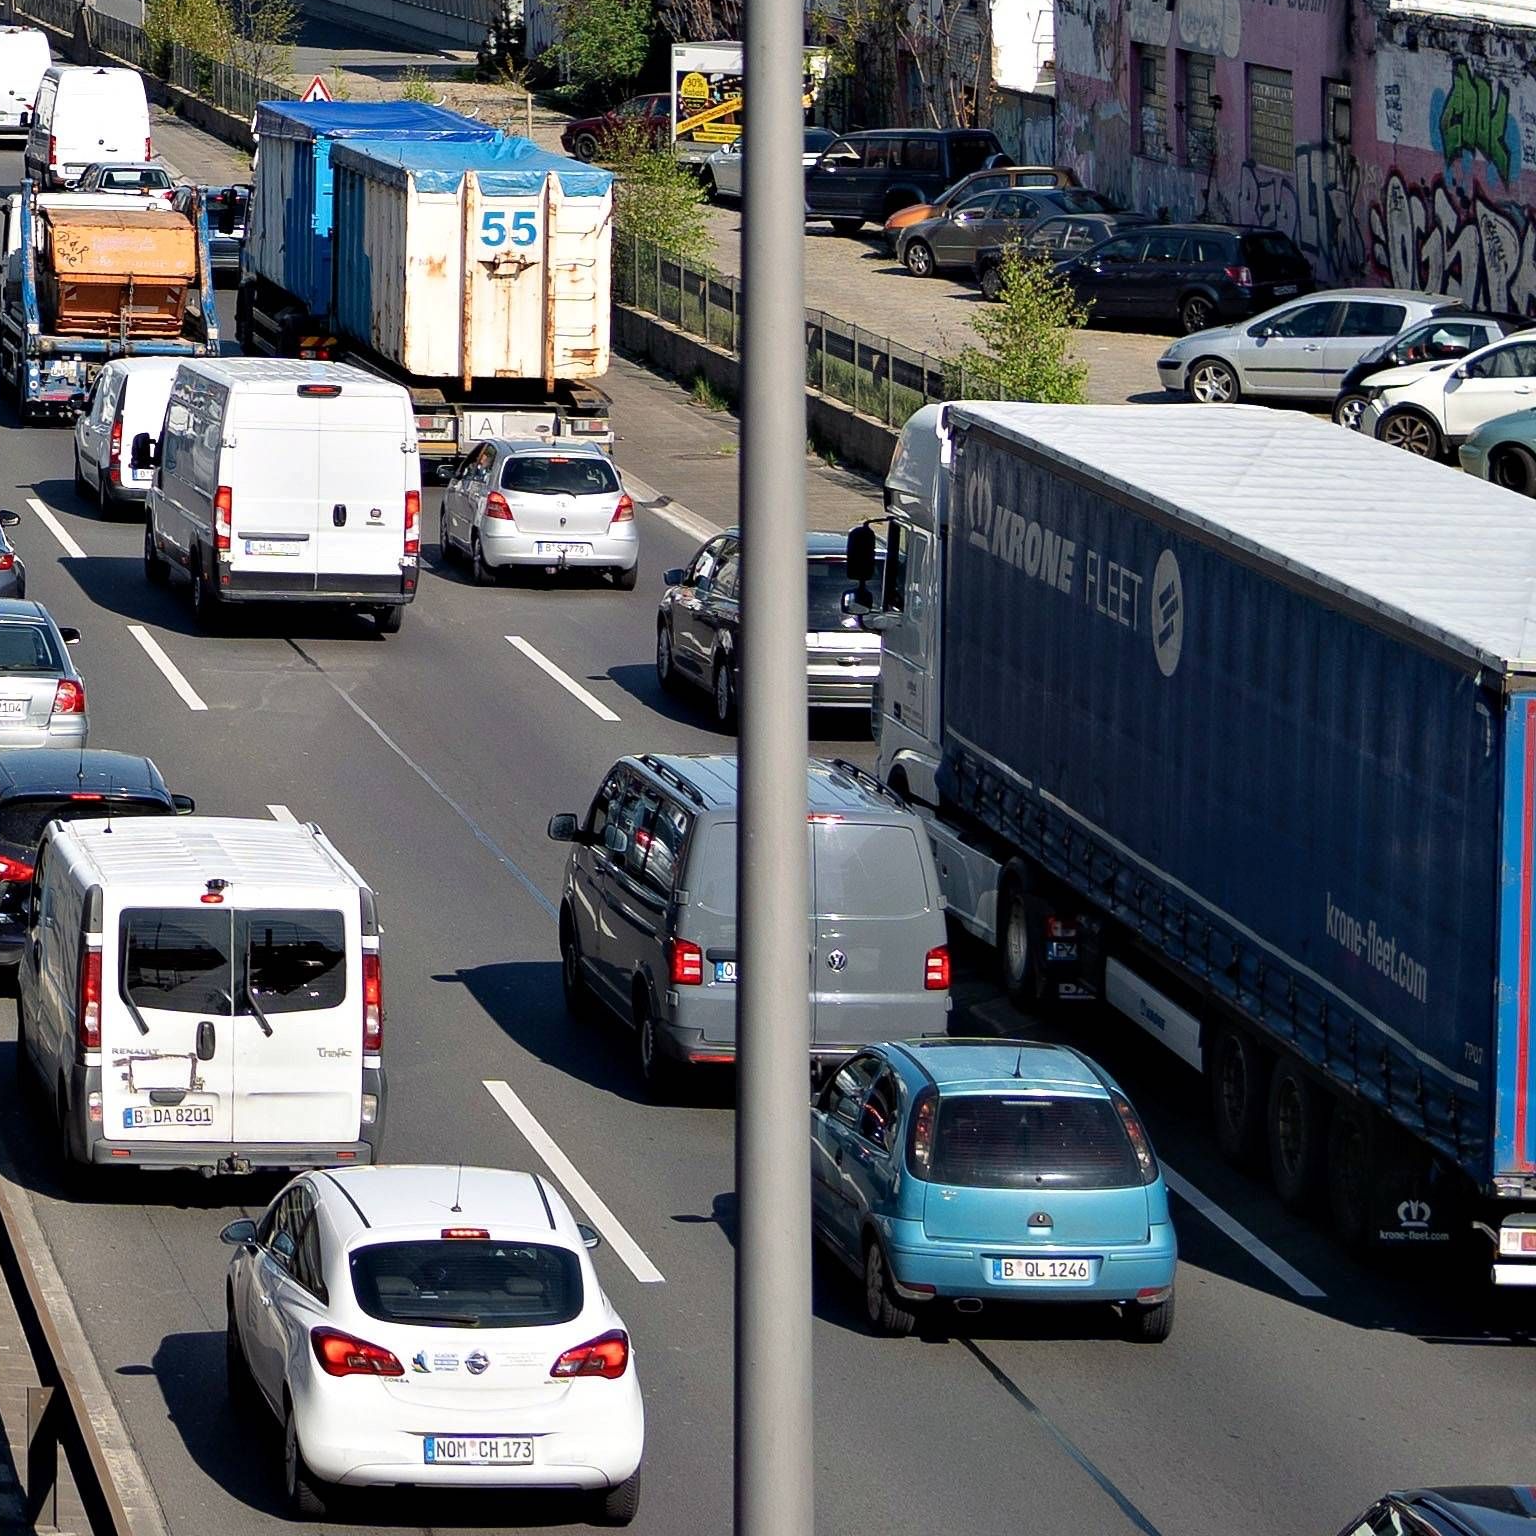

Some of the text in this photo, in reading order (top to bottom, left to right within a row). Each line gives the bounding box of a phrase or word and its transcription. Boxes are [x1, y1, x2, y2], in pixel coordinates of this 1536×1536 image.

[480, 211, 537, 247] 55
[479, 417, 496, 437] A
[992, 504, 1143, 632] KRONE FLEET
[1326, 891, 1428, 1004] krone-fleet.com
[316, 1047, 353, 1058] Trafic
[134, 1108, 212, 1124] B DA 8201
[1379, 1230, 1450, 1241] krone-fleet.com
[1004, 1262, 1087, 1278] B QL 1246
[436, 1440, 532, 1458] NOM CH 173
